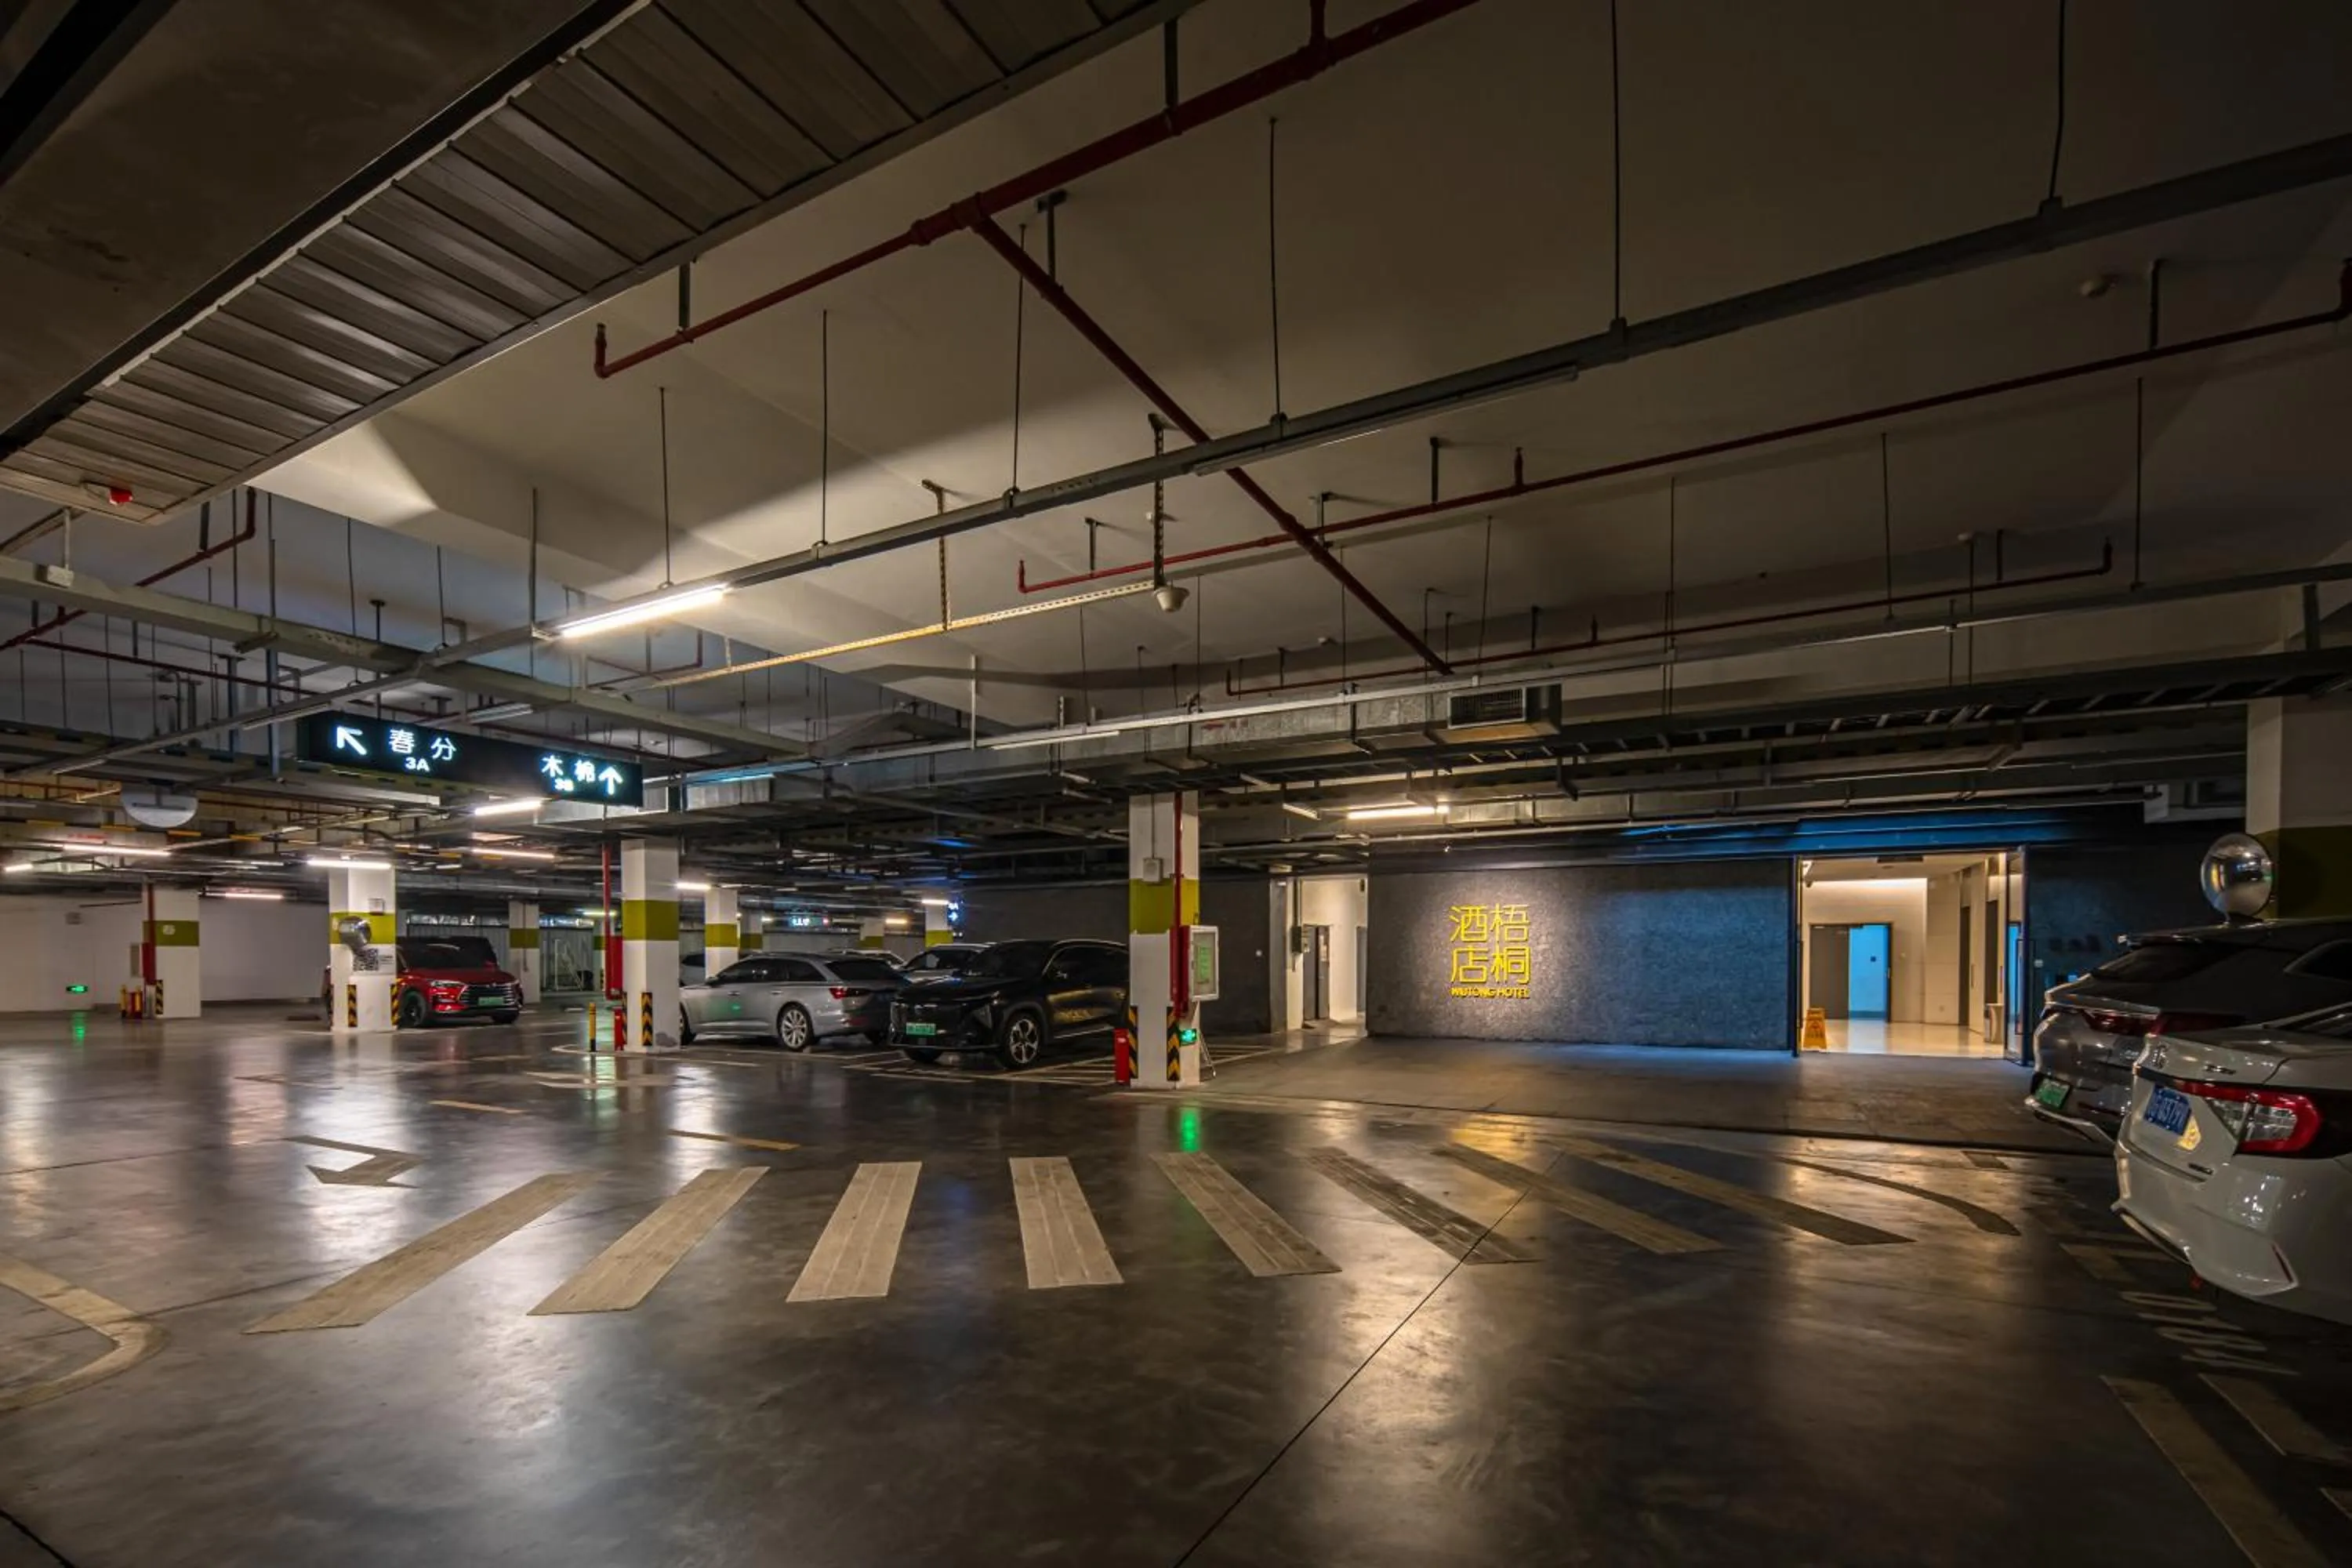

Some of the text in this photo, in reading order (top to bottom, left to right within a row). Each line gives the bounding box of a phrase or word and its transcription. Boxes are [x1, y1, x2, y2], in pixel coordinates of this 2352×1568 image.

[389, 729, 456, 760] 春分
[405, 757, 430, 772] 3A
[1450, 904, 1489, 984] 酒店
[1490, 903, 1531, 984] 梧桐
[1497, 988, 1531, 1000] HOTEL
